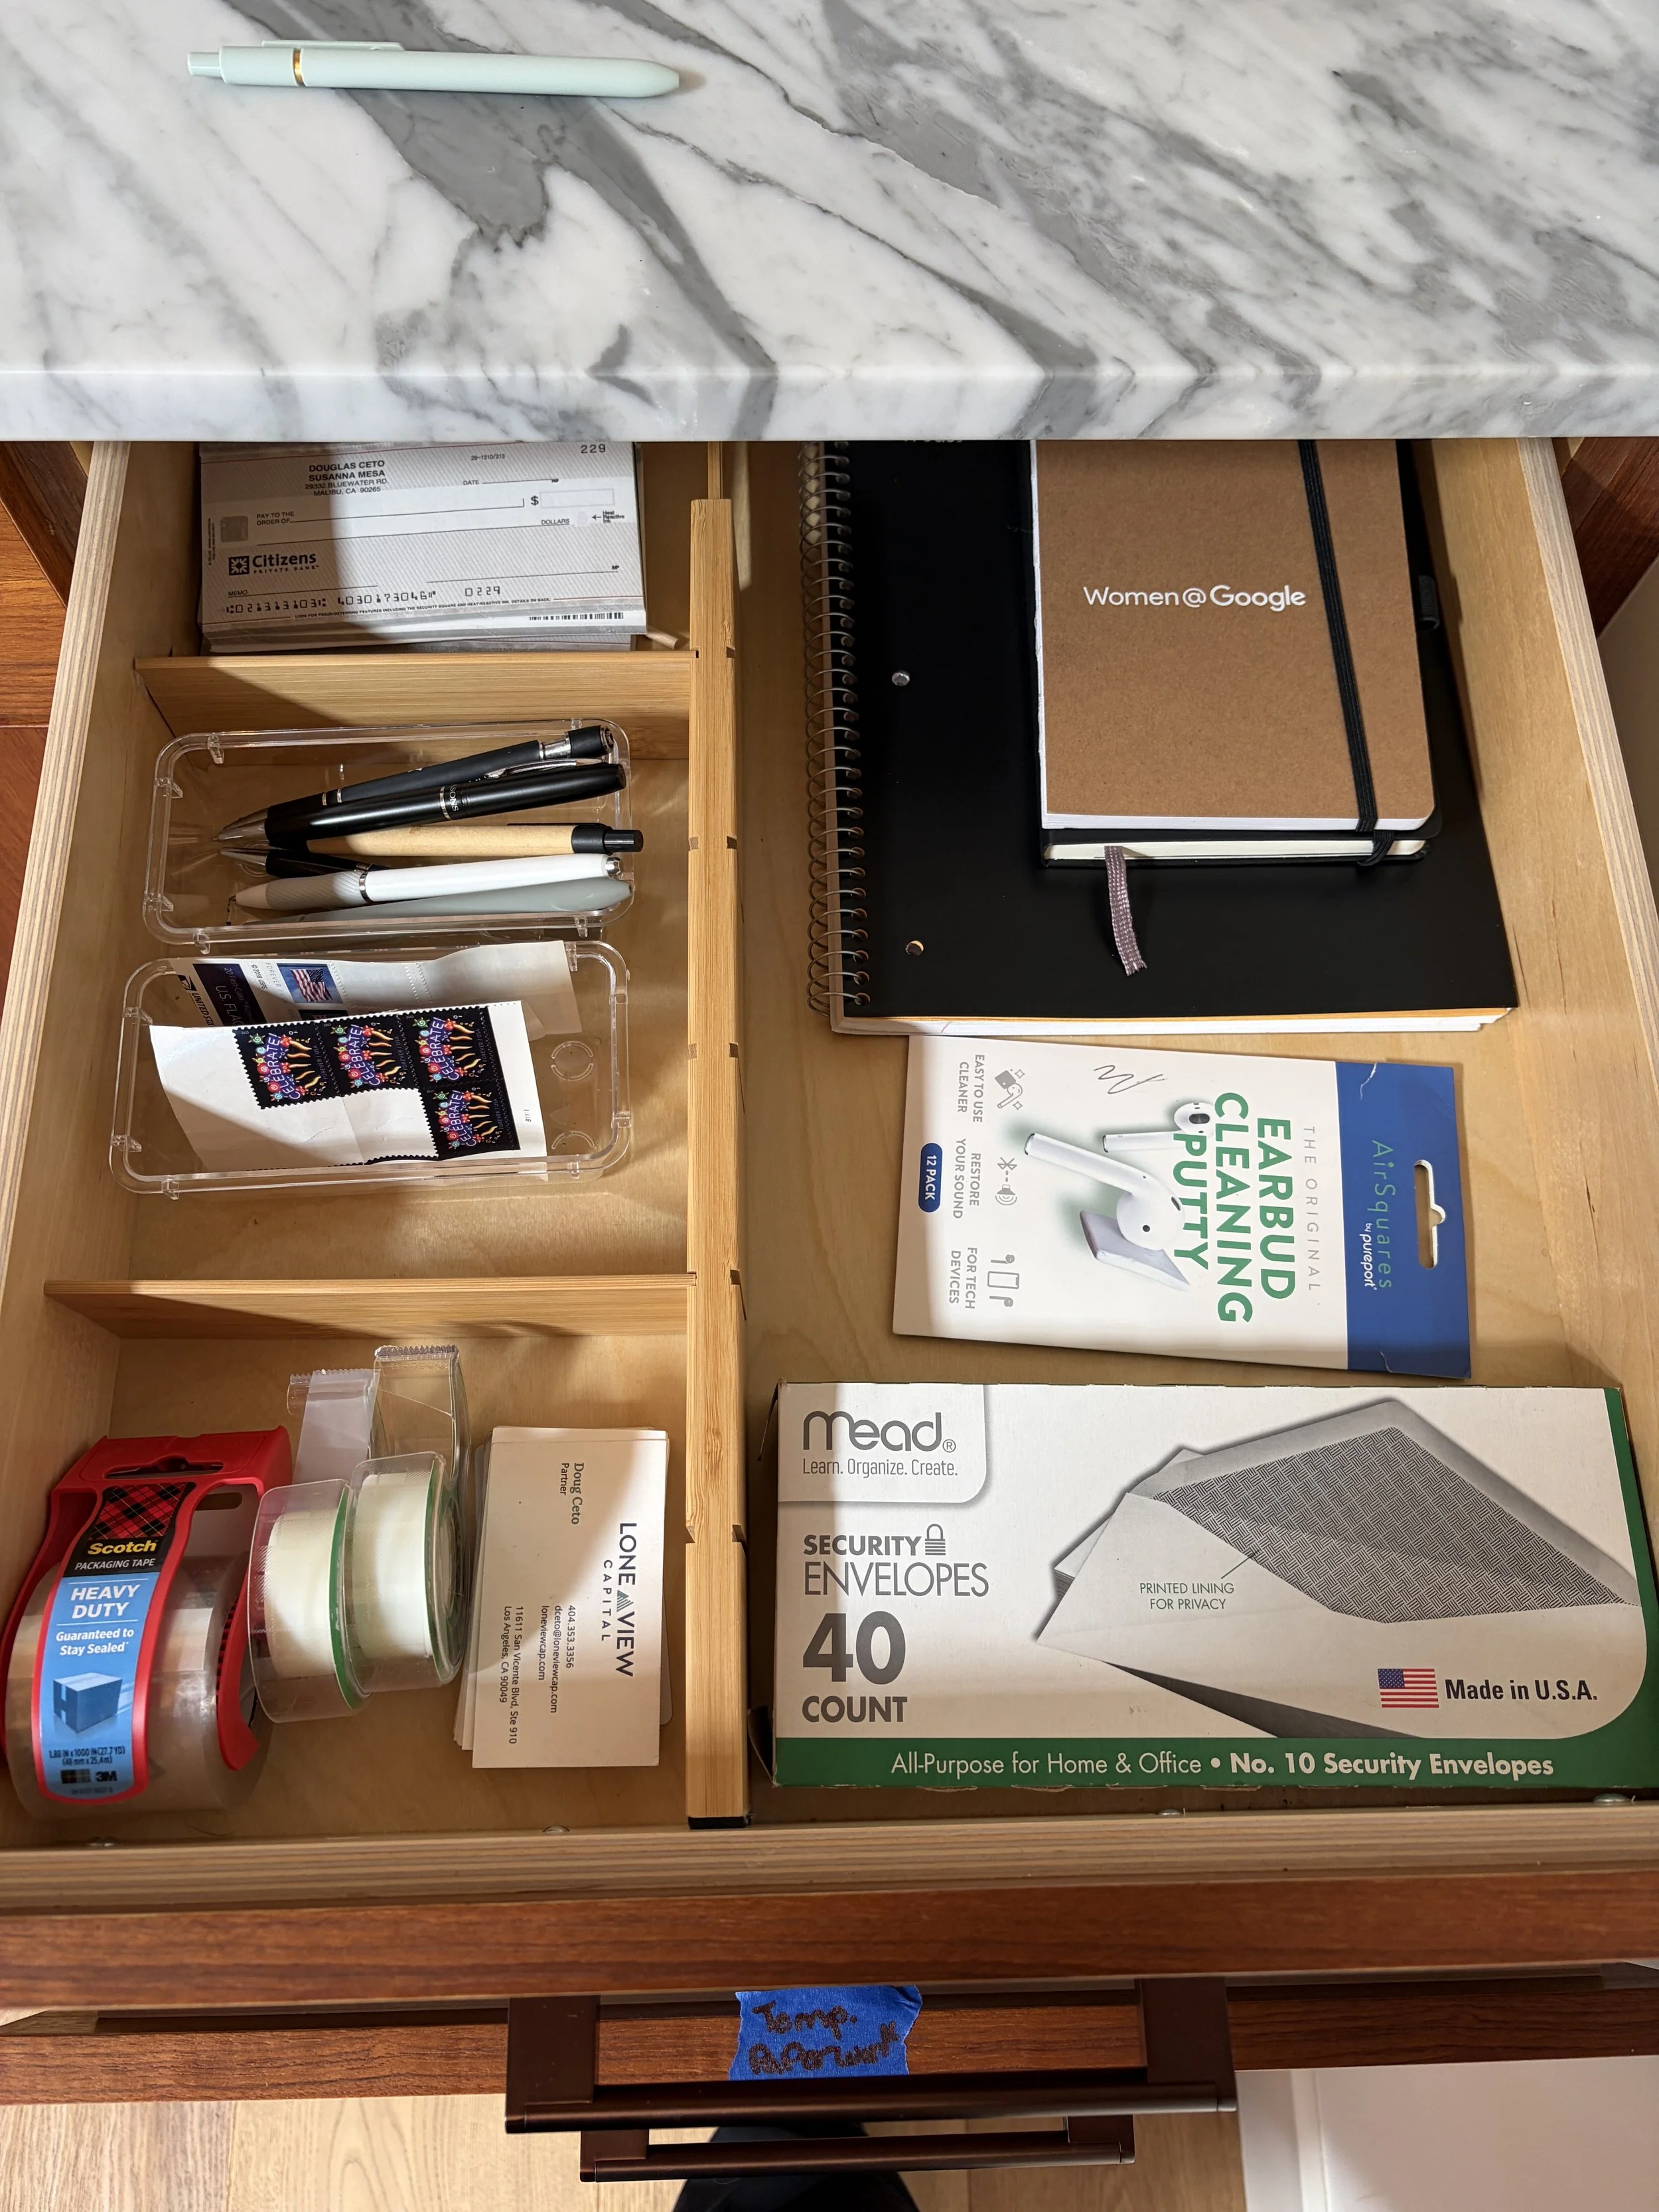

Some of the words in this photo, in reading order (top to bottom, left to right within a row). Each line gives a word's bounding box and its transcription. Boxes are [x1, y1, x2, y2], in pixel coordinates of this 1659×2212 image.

[580, 444, 606, 453] 229
[309, 462, 356, 472] DOUGLAS
[359, 460, 385, 469] CETO
[309, 472, 356, 481] SUSANNA
[531, 495, 539, 506] $
[252, 553, 317, 567] Citizens
[450, 784, 459, 811] SONS
[265, 962, 281, 988] FOREVER
[192, 993, 209, 1017] UNITED
[216, 986, 232, 1001] U.S.
[348, 1024, 380, 1086] CELEBRATE!
[430, 1017, 459, 1080] CELEBRATE!
[266, 1033, 301, 1100] CELEBRATE!
[974, 1055, 985, 1082] EASY
[958, 1062, 969, 1112] CLEANER
[974, 1084, 983, 1098] TO
[449, 1090, 476, 1147] CELEBRATE!
[973, 1102, 983, 1122] USE
[955, 1138, 966, 1172] YOUR
[1303, 1126, 1317, 1163] THE
[926, 1155, 937, 1166] 12
[924, 1169, 936, 1201] PACK
[970, 1153, 981, 1206] RESTORE
[953, 1175, 964, 1218] SOUND
[1173, 1134, 1209, 1270] PUTTY
[1214, 1093, 1253, 1322] CLEANING
[1257, 1118, 1296, 1299] EARBUD
[1364, 1223, 1372, 1232] by
[1367, 1140, 1396, 1288] AirSquares
[1305, 1179, 1321, 1291] ORIGINAL
[966, 1247, 977, 1273] FOR
[949, 1250, 961, 1303] DEVICES
[965, 1276, 976, 1309] TECH
[559, 1462, 569, 1496] Partner
[571, 1462, 585, 1494] Doug
[802, 1458, 843, 1475] Learn.
[847, 1458, 908, 1478] Organize.
[911, 1459, 958, 1477] Create.
[571, 1497, 584, 1525] Ceto
[88, 1540, 157, 1555] Scotch
[618, 1522, 638, 1586] LONE
[803, 1534, 922, 1556] SECURITY
[75, 1560, 129, 1570] PACKAGING
[131, 1558, 156, 1567] TAPE
[70, 1584, 141, 1601] HEAVY
[804, 1561, 989, 1597] ENVELOPES
[1139, 1583, 1188, 1594] PRINTED
[1192, 1582, 1234, 1594] LINING
[72, 1602, 129, 1619] DUTY
[601, 1560, 613, 1641] CAPITAL
[1150, 1599, 1175, 1610] FOR
[1178, 1598, 1226, 1610] PRIVACY
[515, 1606, 524, 1631] 11611
[56, 1628, 121, 1642] Guaranteed
[122, 1628, 134, 1638] to
[501, 1623, 511, 1659] Angeles,
[514, 1635, 522, 1651] San
[537, 1605, 550, 1680] loneviewcap.com
[566, 1605, 576, 1668] 404.353.3356
[615, 1611, 635, 1677] VIEW
[802, 1611, 906, 1686] 40
[60, 1645, 85, 1657] Stay
[549, 1605, 563, 1714] dceto@loneviewcap.com
[501, 1662, 509, 1674] CA
[512, 1653, 521, 1685] Vicente
[500, 1676, 508, 1703] 90049
[510, 1687, 520, 1708] Blvd,
[1445, 1679, 1504, 1700] Made
[1510, 1680, 1530, 1700] in
[1536, 1680, 1598, 1701] U.S.A.
[510, 1711, 518, 1726] Ste
[802, 1695, 908, 1724] COUNT
[508, 1728, 518, 1744] 910
[95, 1771, 117, 1782] 3M
[891, 1752, 1005, 1779] All-Purpose
[1011, 1751, 1041, 1774] for
[1047, 1753, 1108, 1773] Home
[1115, 1754, 1132, 1773] &
[1139, 1751, 1202, 1773] Office
[1230, 1753, 1275, 1774] No.
[1285, 1753, 1316, 1775] 10
[1324, 1752, 1422, 1781] Security
[1430, 1752, 1554, 1781] Envelopes
